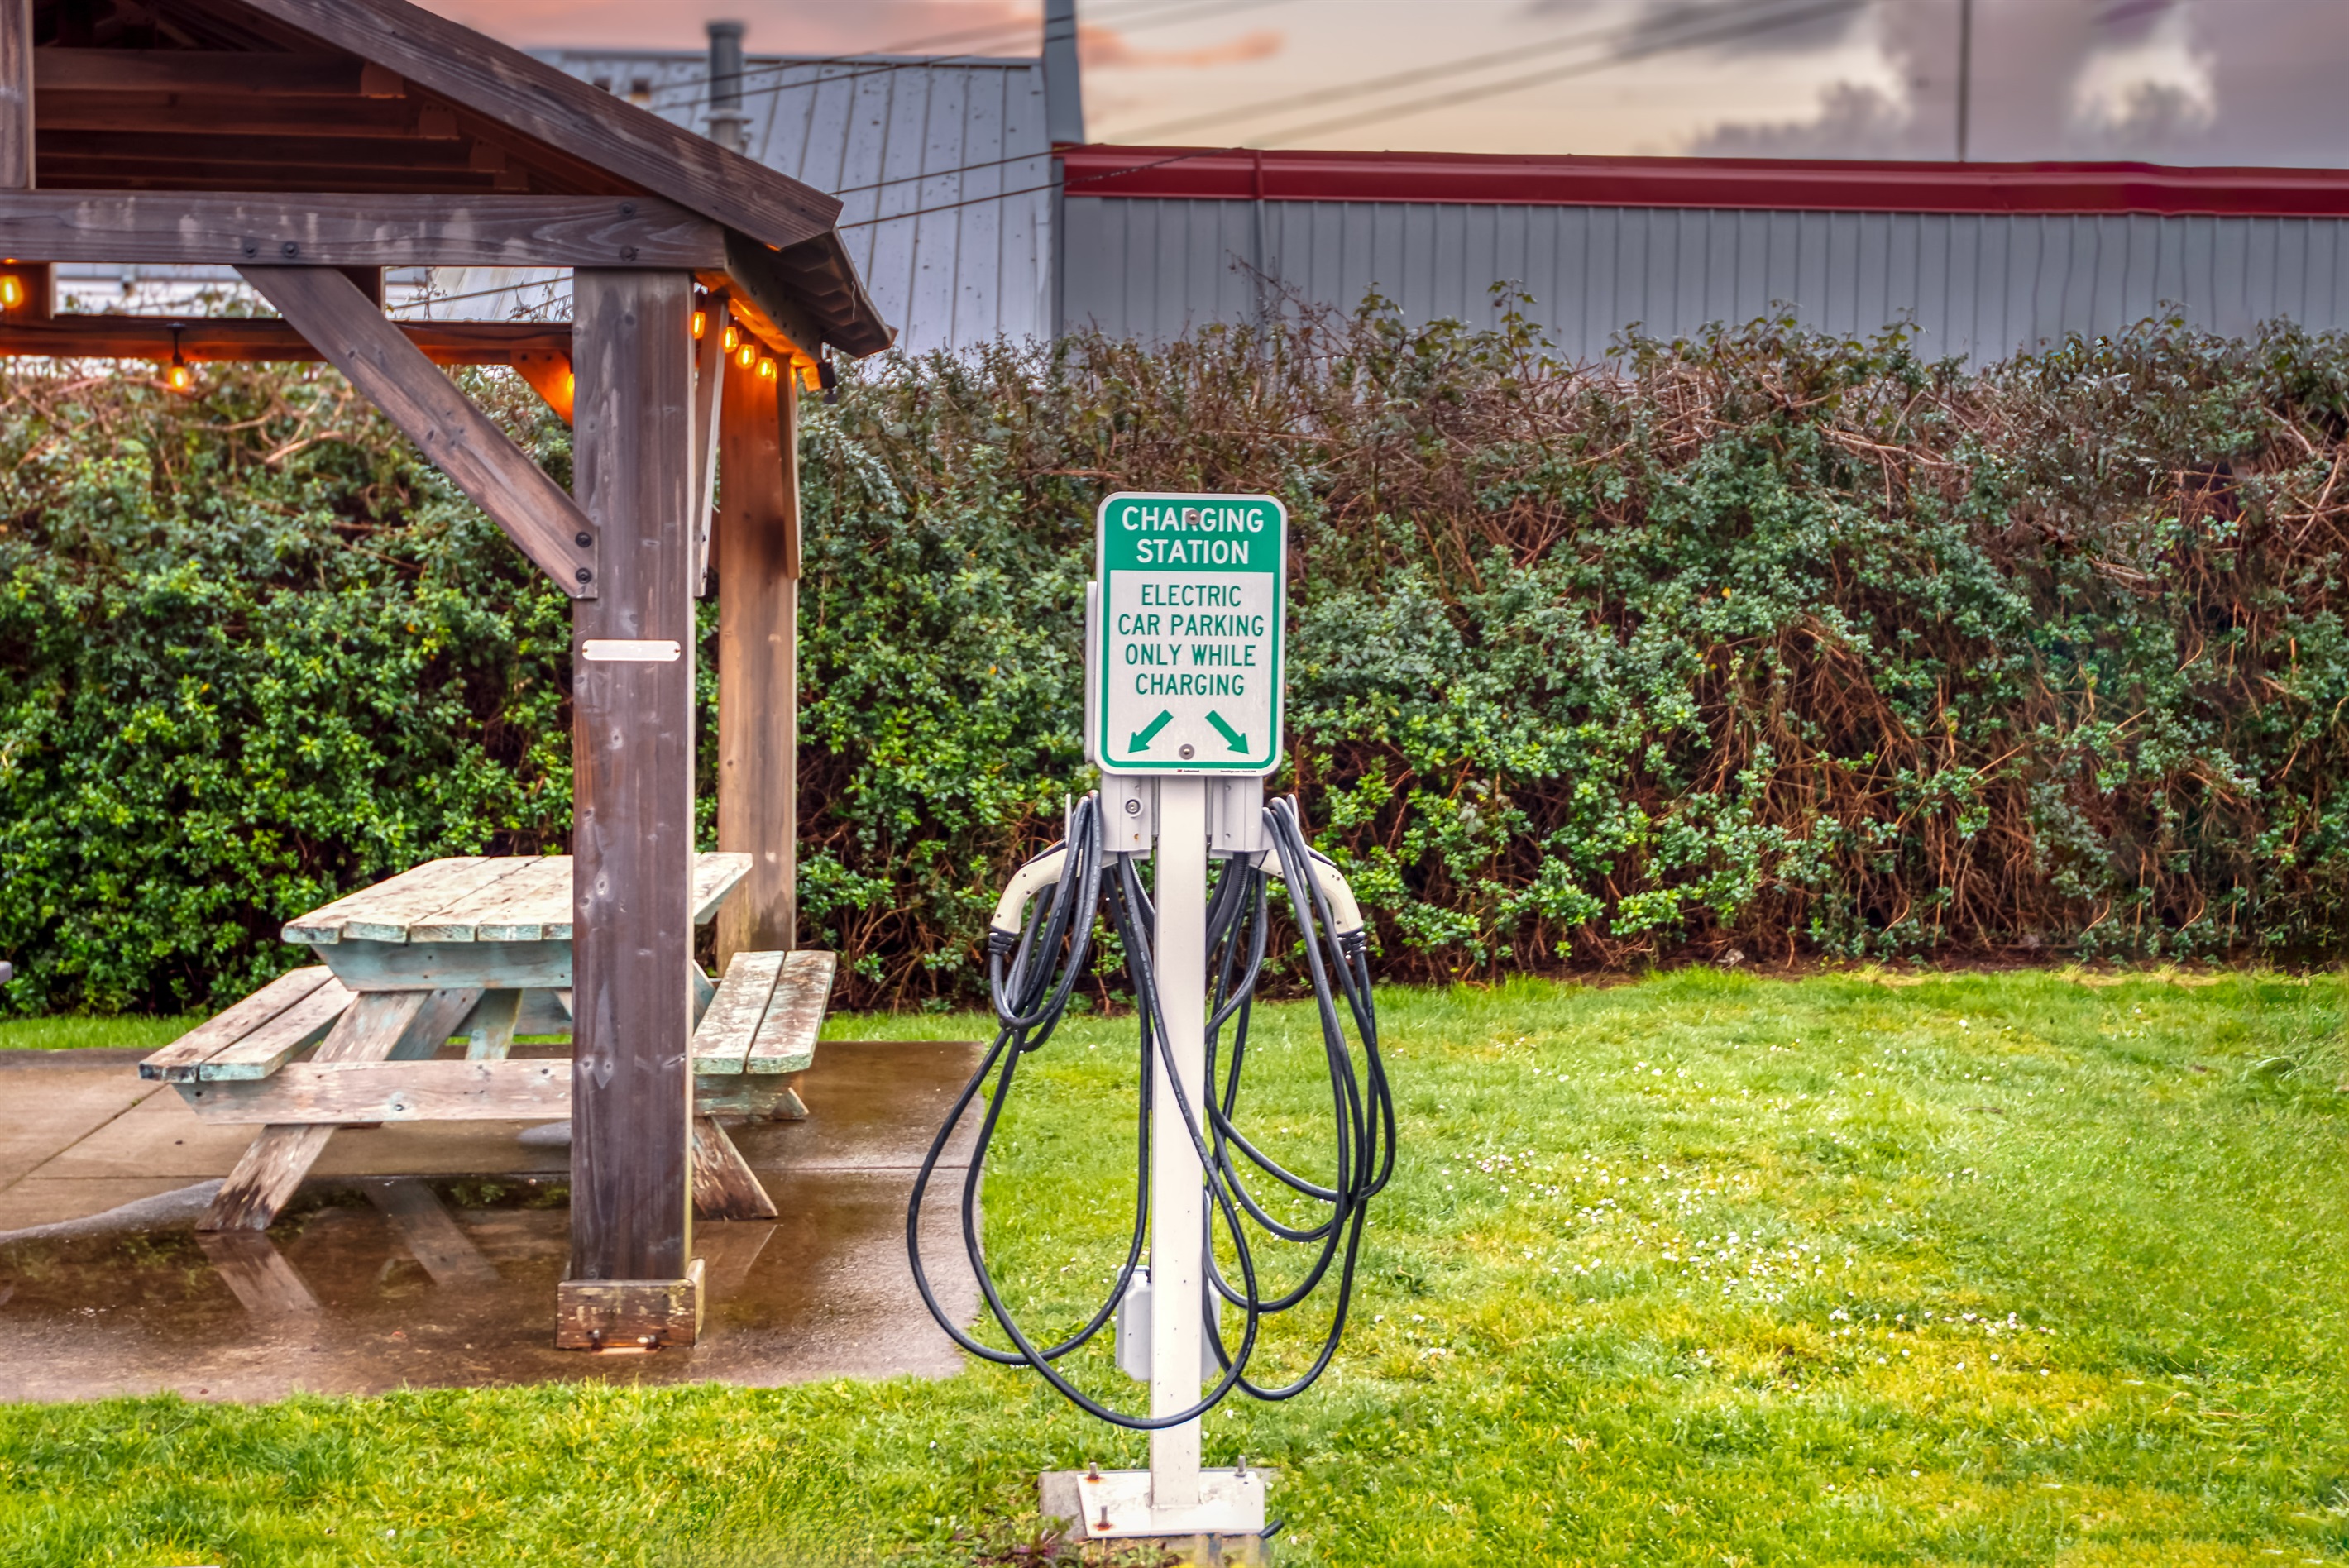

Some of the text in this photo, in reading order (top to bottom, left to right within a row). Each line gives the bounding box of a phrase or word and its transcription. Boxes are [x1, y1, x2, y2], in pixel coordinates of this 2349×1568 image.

[1122, 506, 1264, 533] CHARGING
[1136, 539, 1249, 563] STATION
[1142, 584, 1241, 606] ELECTRIC
[1118, 614, 1264, 636] CAR PARKING
[1125, 643, 1256, 667] ONLY WHILE
[1136, 674, 1244, 696] CHARGING
